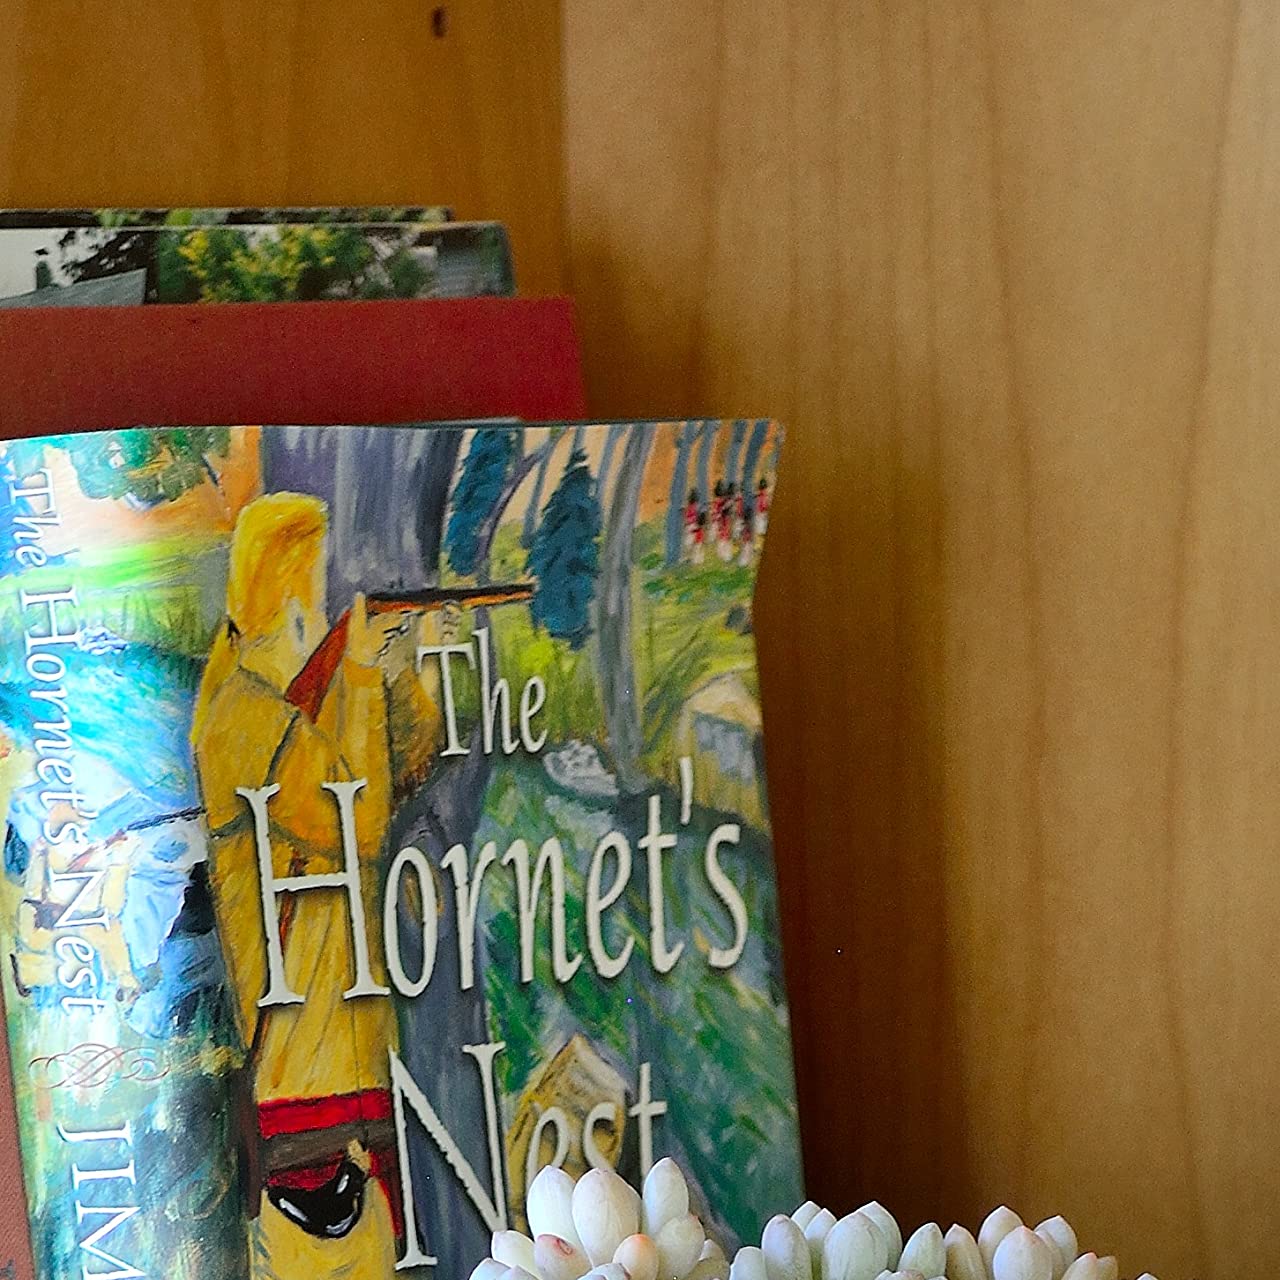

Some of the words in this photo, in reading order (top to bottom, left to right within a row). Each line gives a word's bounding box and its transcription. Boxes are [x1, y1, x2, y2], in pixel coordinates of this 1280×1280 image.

[9, 468, 62, 567] The
[20, 585, 98, 849] Hornet's
[416, 628, 547, 757] The
[50, 868, 110, 1016] Nest
[238, 757, 749, 1008] Hornet's
